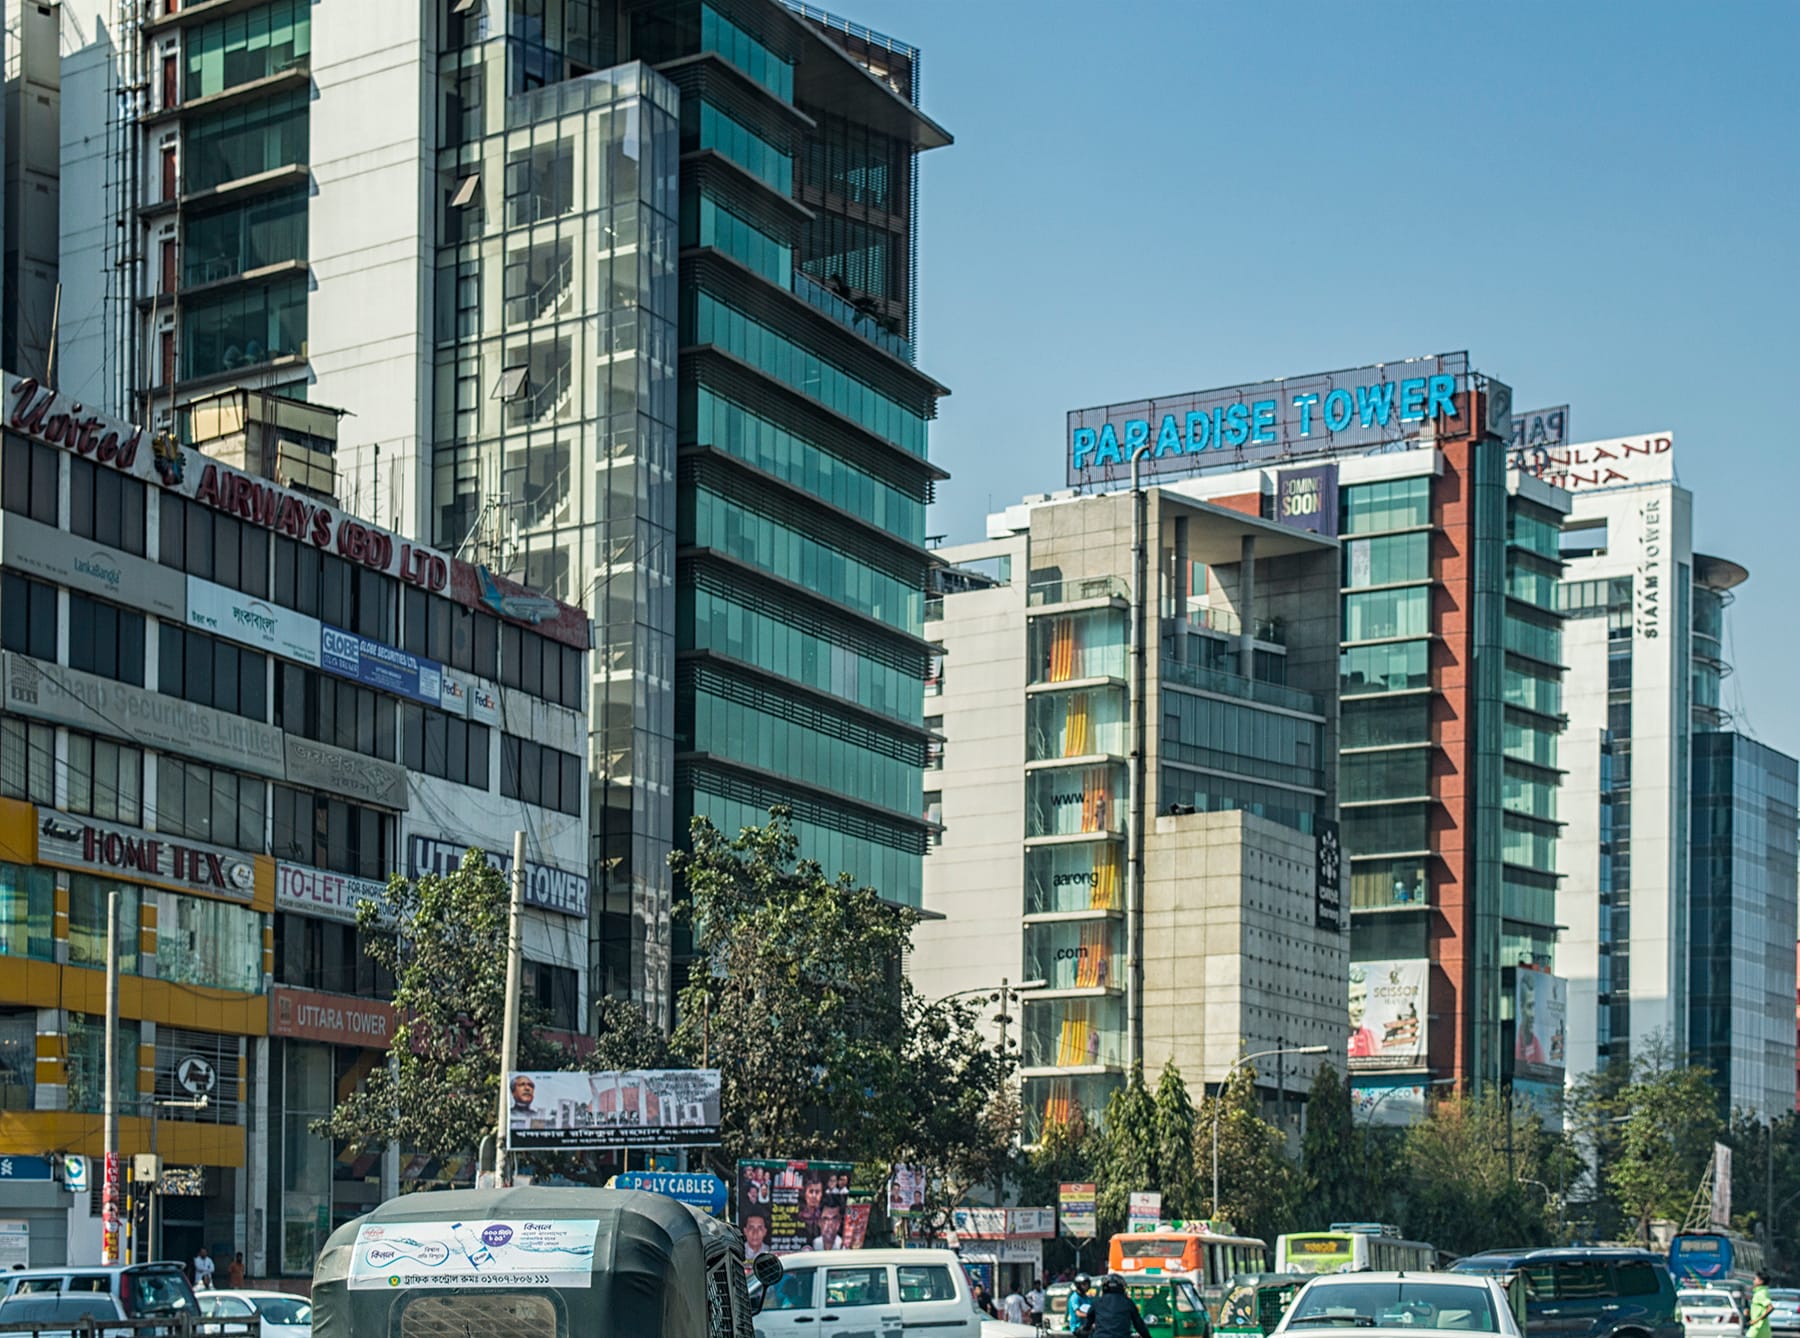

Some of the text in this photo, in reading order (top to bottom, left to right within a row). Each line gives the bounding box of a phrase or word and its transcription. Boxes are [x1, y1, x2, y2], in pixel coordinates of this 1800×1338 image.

[1073, 374, 1457, 470] PARADISE TOWER
[12, 377, 448, 591] United AIRWAYS (BD) LTD
[1282, 476, 1322, 495] COMING
[1282, 493, 1322, 516] SOON
[1644, 499, 1660, 639] SIAAM TOWER
[324, 631, 359, 660] GLOBE
[360, 640, 377, 656] GLOBE
[377, 646, 407, 666] SECURITIES
[443, 679, 463, 698] FedEx
[475, 691, 495, 710] FedEx
[45, 665, 281, 755] Sharp Securities Limited
[1051, 791, 1089, 807] www.
[83, 826, 164, 876] HOME
[169, 844, 226, 889] TEX
[280, 867, 345, 906] TO-LET
[526, 863, 587, 914] TOWER
[1053, 871, 1099, 888] aarong
[1053, 946, 1088, 960] .com
[297, 1005, 386, 1035] UTTARA TOWER
[635, 1177, 714, 1194] POLY CABLES
